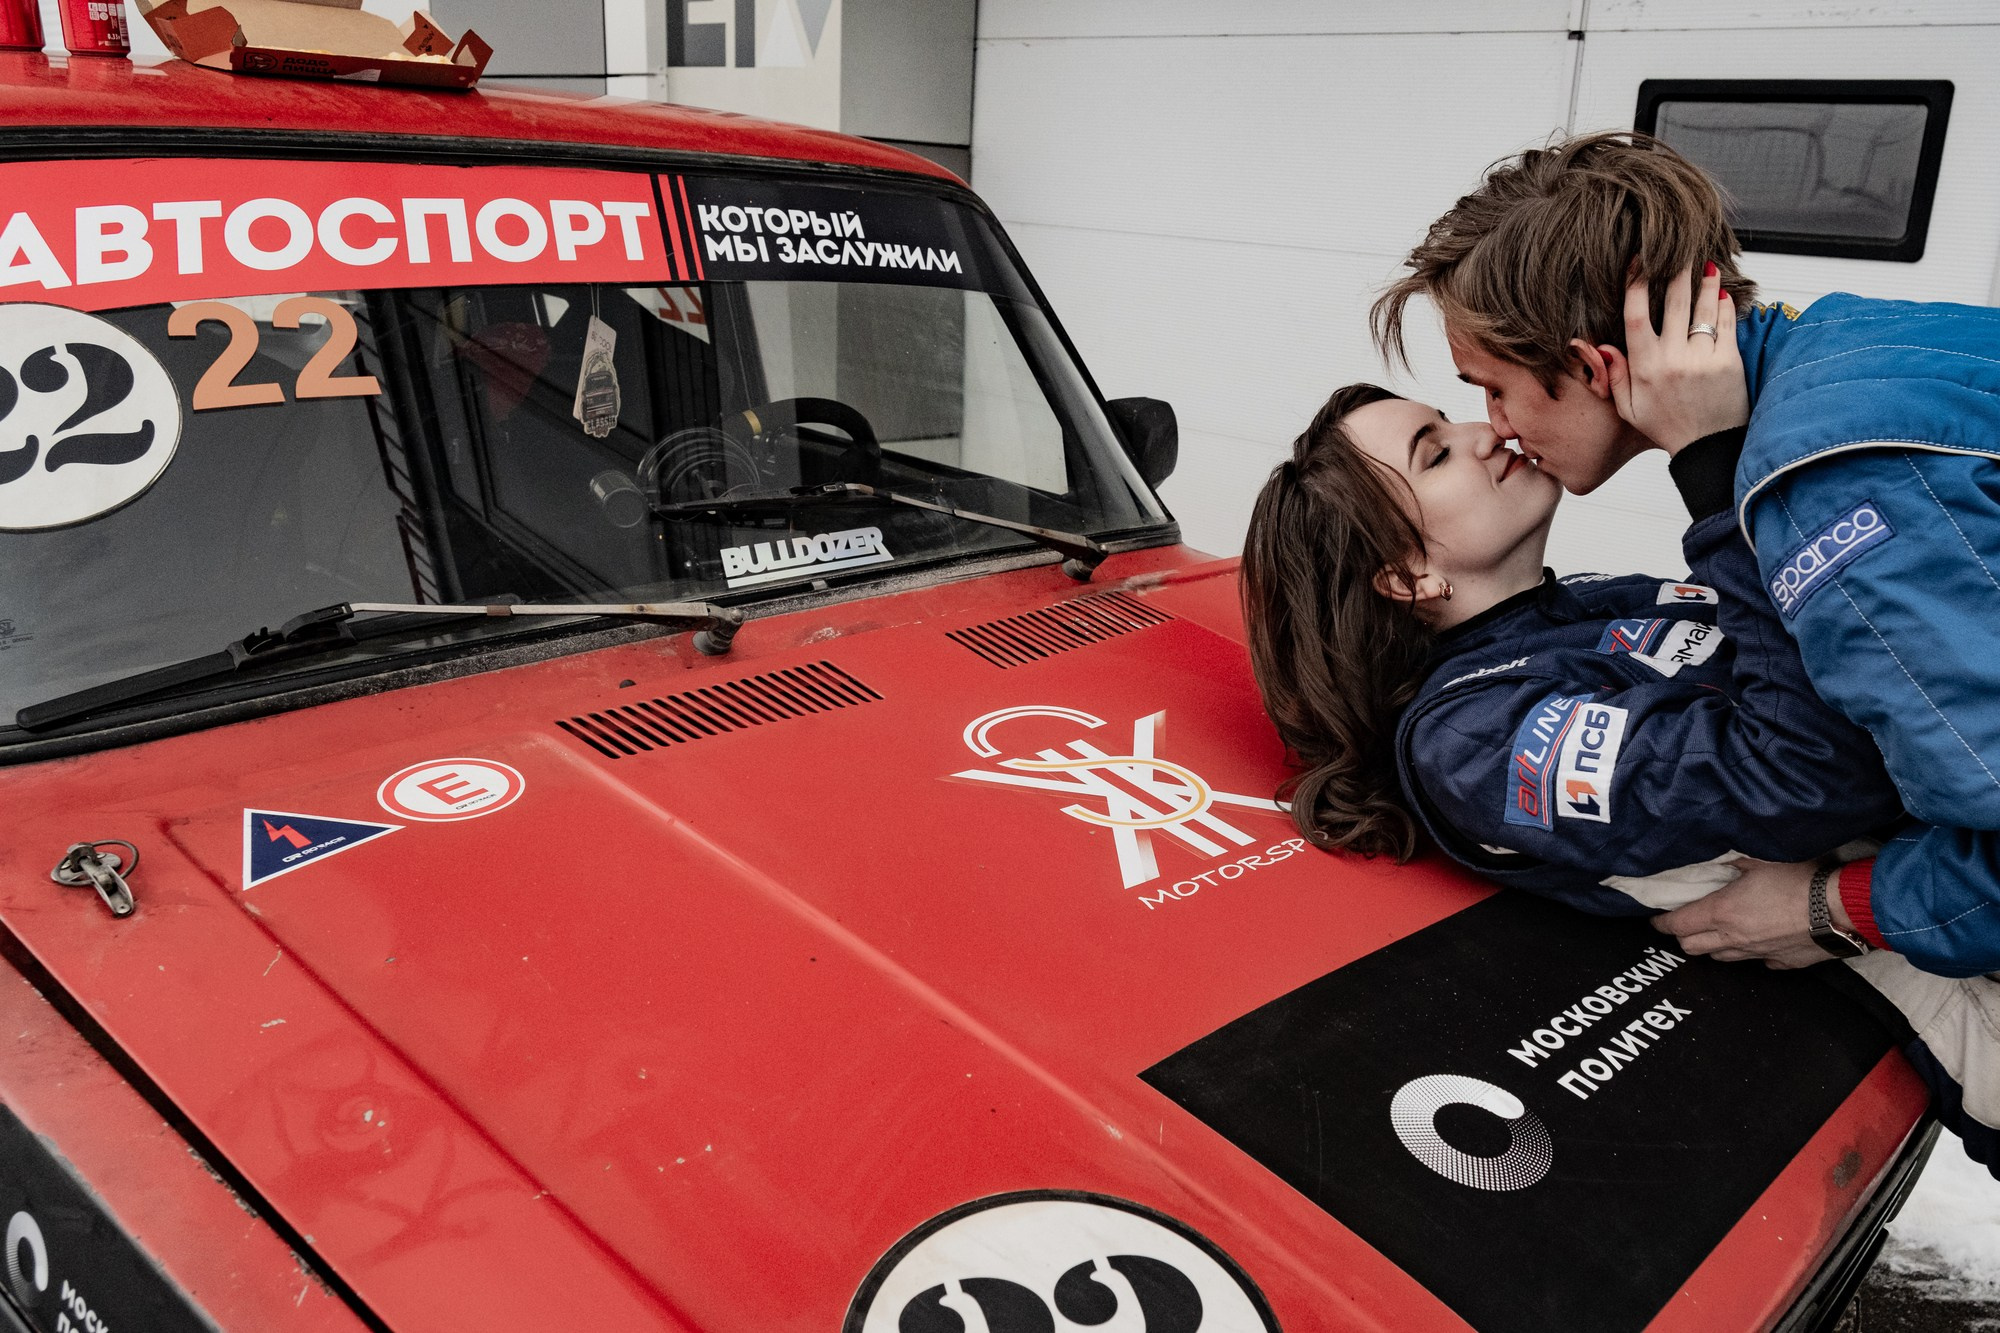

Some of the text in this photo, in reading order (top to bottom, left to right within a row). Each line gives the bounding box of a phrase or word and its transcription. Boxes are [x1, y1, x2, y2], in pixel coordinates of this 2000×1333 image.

[0, 197, 651, 290] АВТОСПОРТ
[698, 204, 866, 239] КОТОРЫЙ
[704, 235, 963, 275] МЫ ЗАСЛУЖИЛИ
[167, 296, 382, 411] 22
[719, 526, 888, 580] BULLDOZER
[1772, 508, 1878, 602] sparco
[1574, 709, 1611, 773] ПСБ
[416, 772, 489, 806] E
[1138, 838, 1305, 910] MOTORSP
